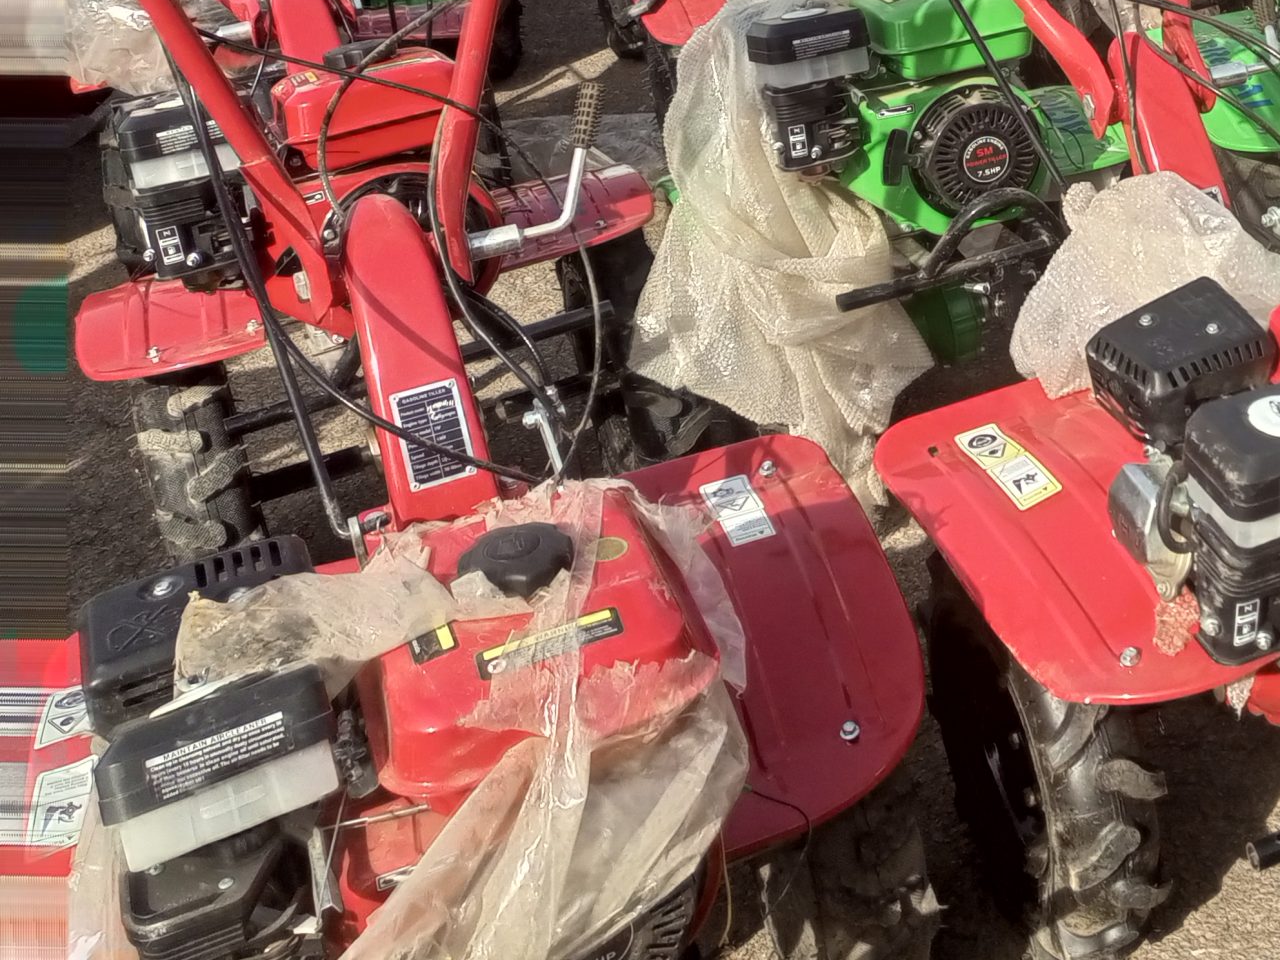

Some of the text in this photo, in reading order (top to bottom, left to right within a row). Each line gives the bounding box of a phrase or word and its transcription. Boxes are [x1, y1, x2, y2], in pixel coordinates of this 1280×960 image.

[976, 146, 993, 157] SM
[977, 166, 1001, 178] 7.5HP
[163, 719, 267, 761] MAINTAIN AIRCLEANER
